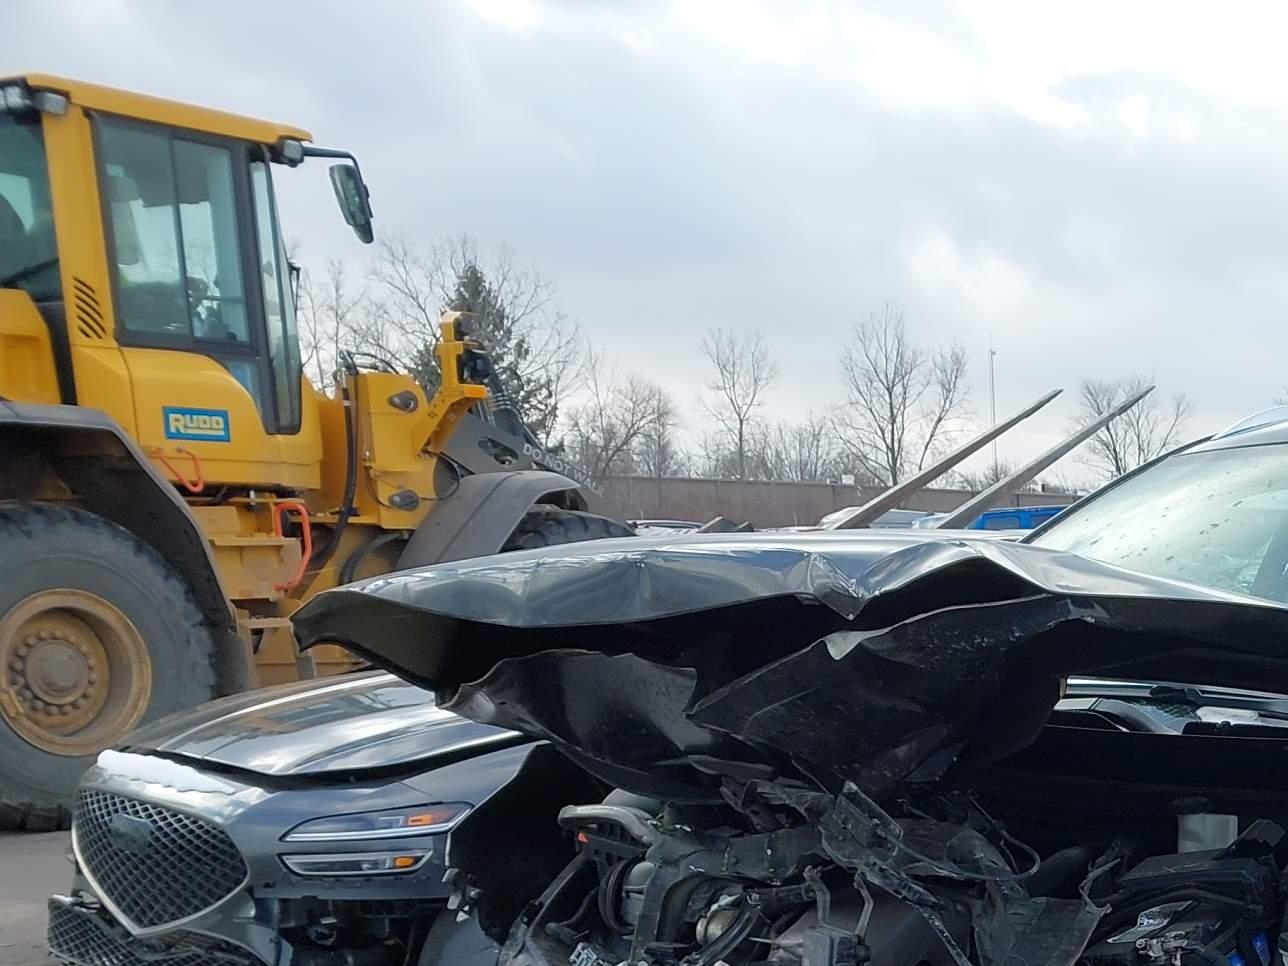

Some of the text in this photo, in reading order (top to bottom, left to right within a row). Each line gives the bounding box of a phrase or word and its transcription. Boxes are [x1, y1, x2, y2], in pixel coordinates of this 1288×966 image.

[168, 413, 225, 435] RUDD
[523, 443, 543, 460] DO
[543, 453, 572, 476] NOT
